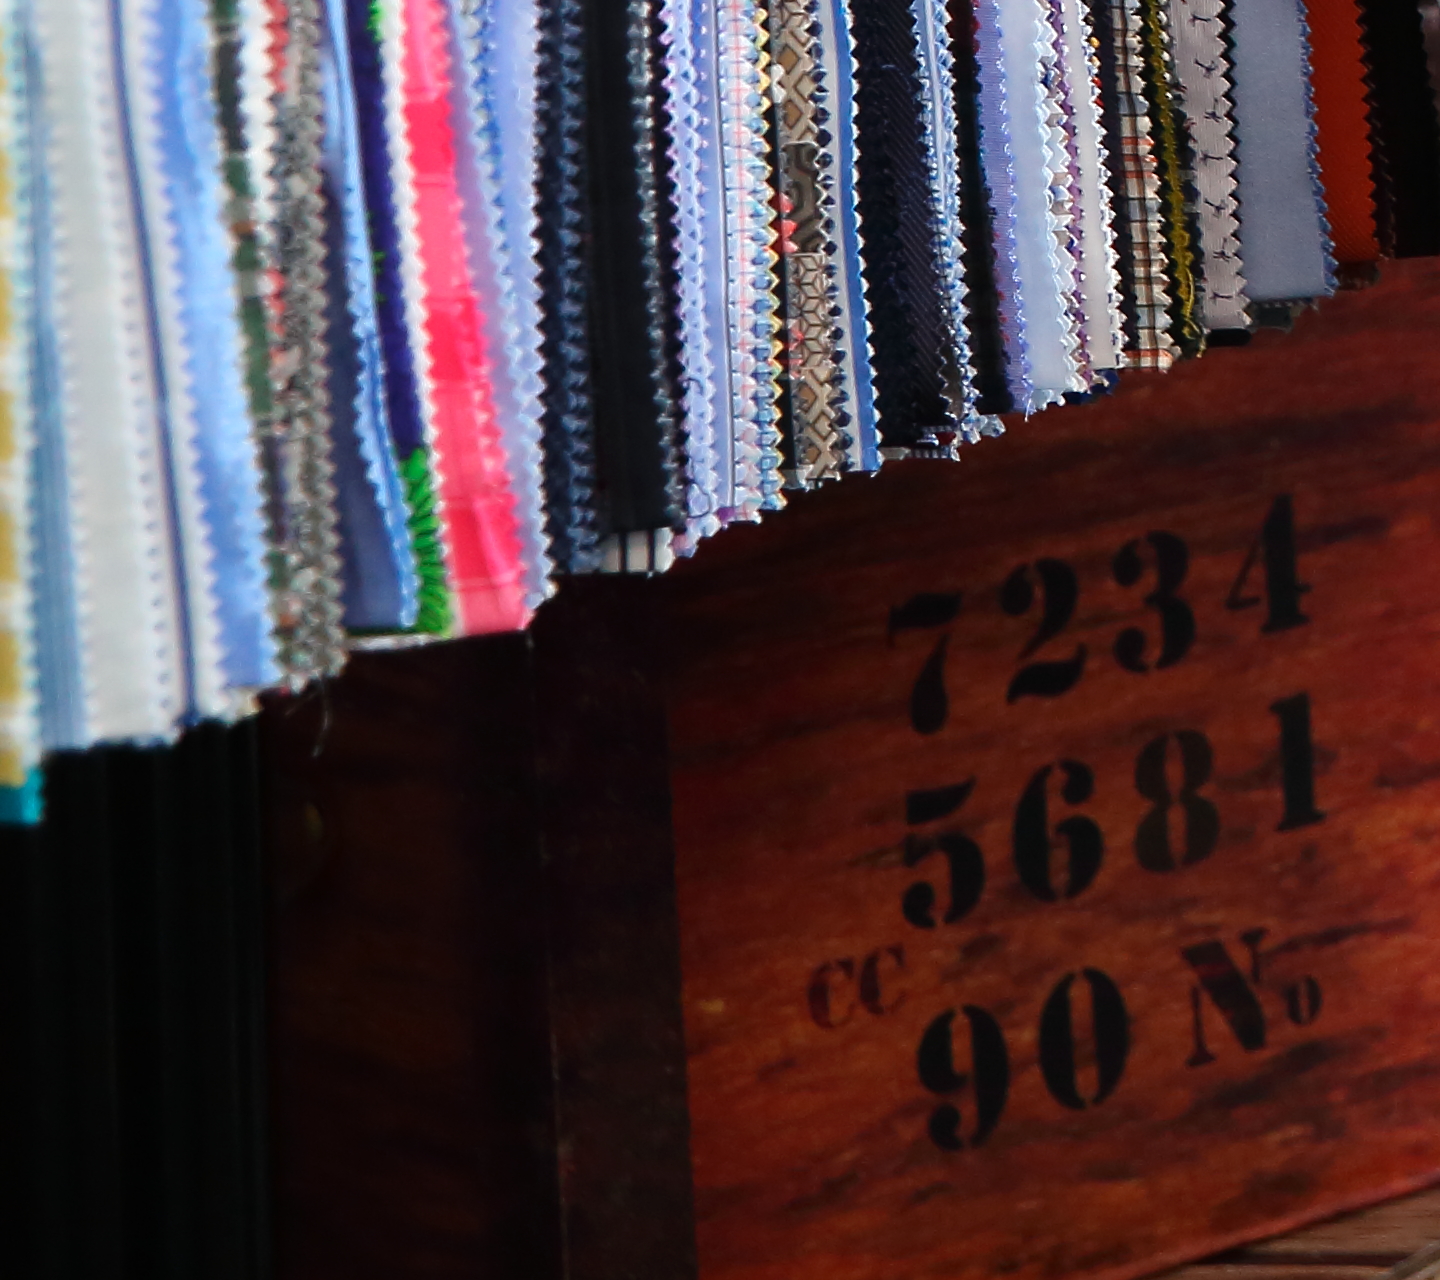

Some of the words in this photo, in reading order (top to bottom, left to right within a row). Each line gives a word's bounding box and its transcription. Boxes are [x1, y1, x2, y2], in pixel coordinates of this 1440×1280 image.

[888, 493, 1312, 734] 7234
[902, 692, 1326, 929] 5681
[916, 966, 1130, 1151] 90
